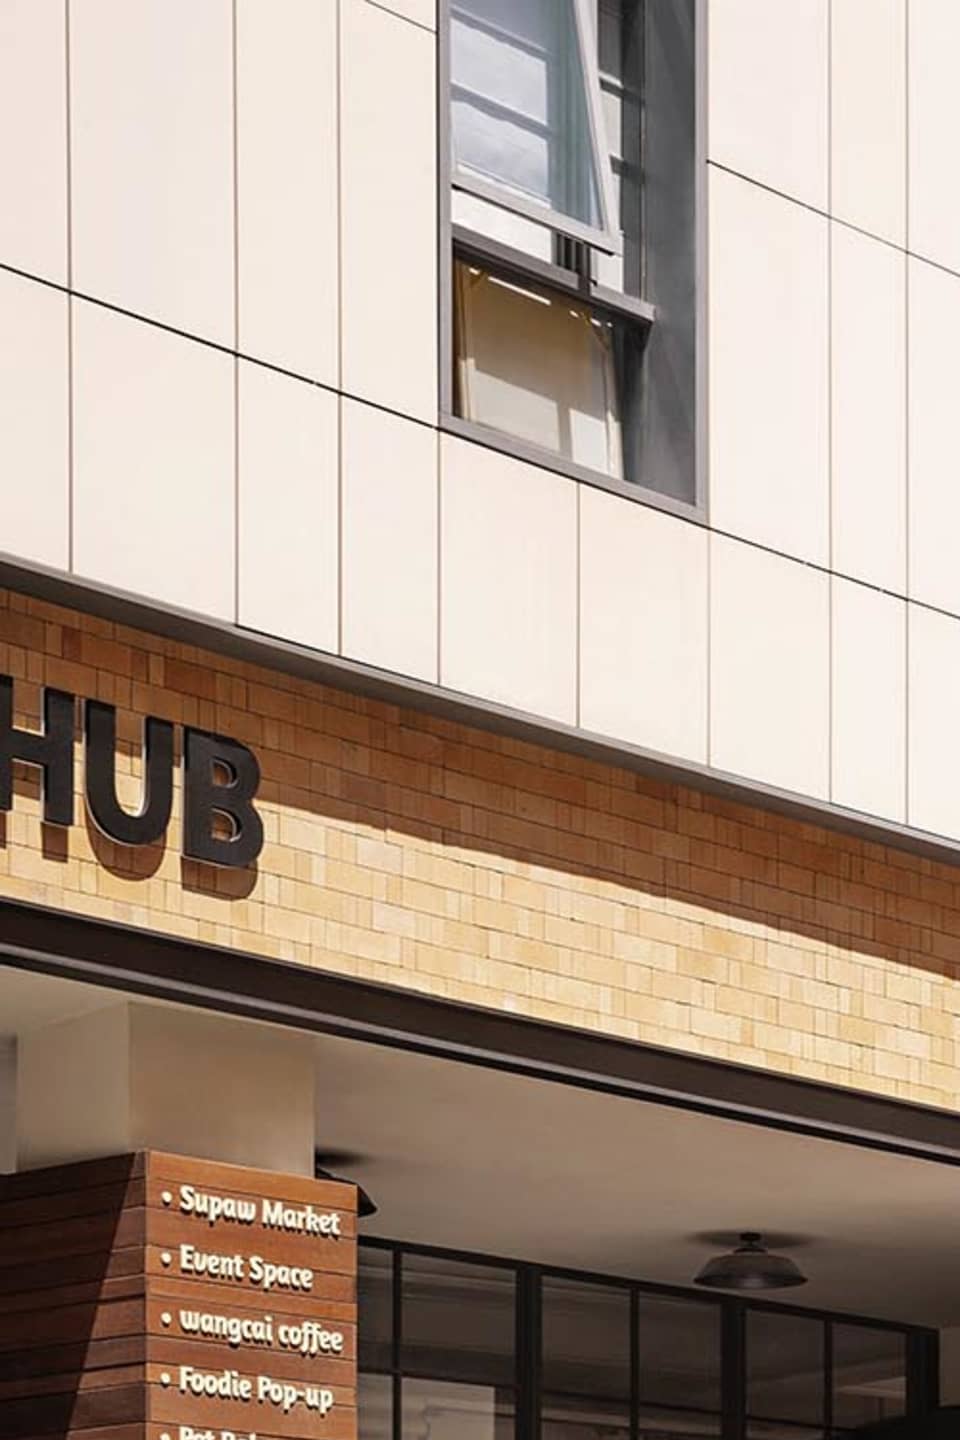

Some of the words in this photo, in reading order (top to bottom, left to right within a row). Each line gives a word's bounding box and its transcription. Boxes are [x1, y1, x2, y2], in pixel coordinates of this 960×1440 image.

[0, 675, 264, 866] HUB
[180, 1185, 256, 1221] Supaw
[262, 1199, 341, 1235] Market
[180, 1245, 244, 1278] Event
[249, 1255, 313, 1288] Space
[180, 1310, 273, 1344] wangcai
[278, 1321, 344, 1354] coffee
[180, 1366, 252, 1398] Foodie
[257, 1376, 334, 1414] Pop-up
